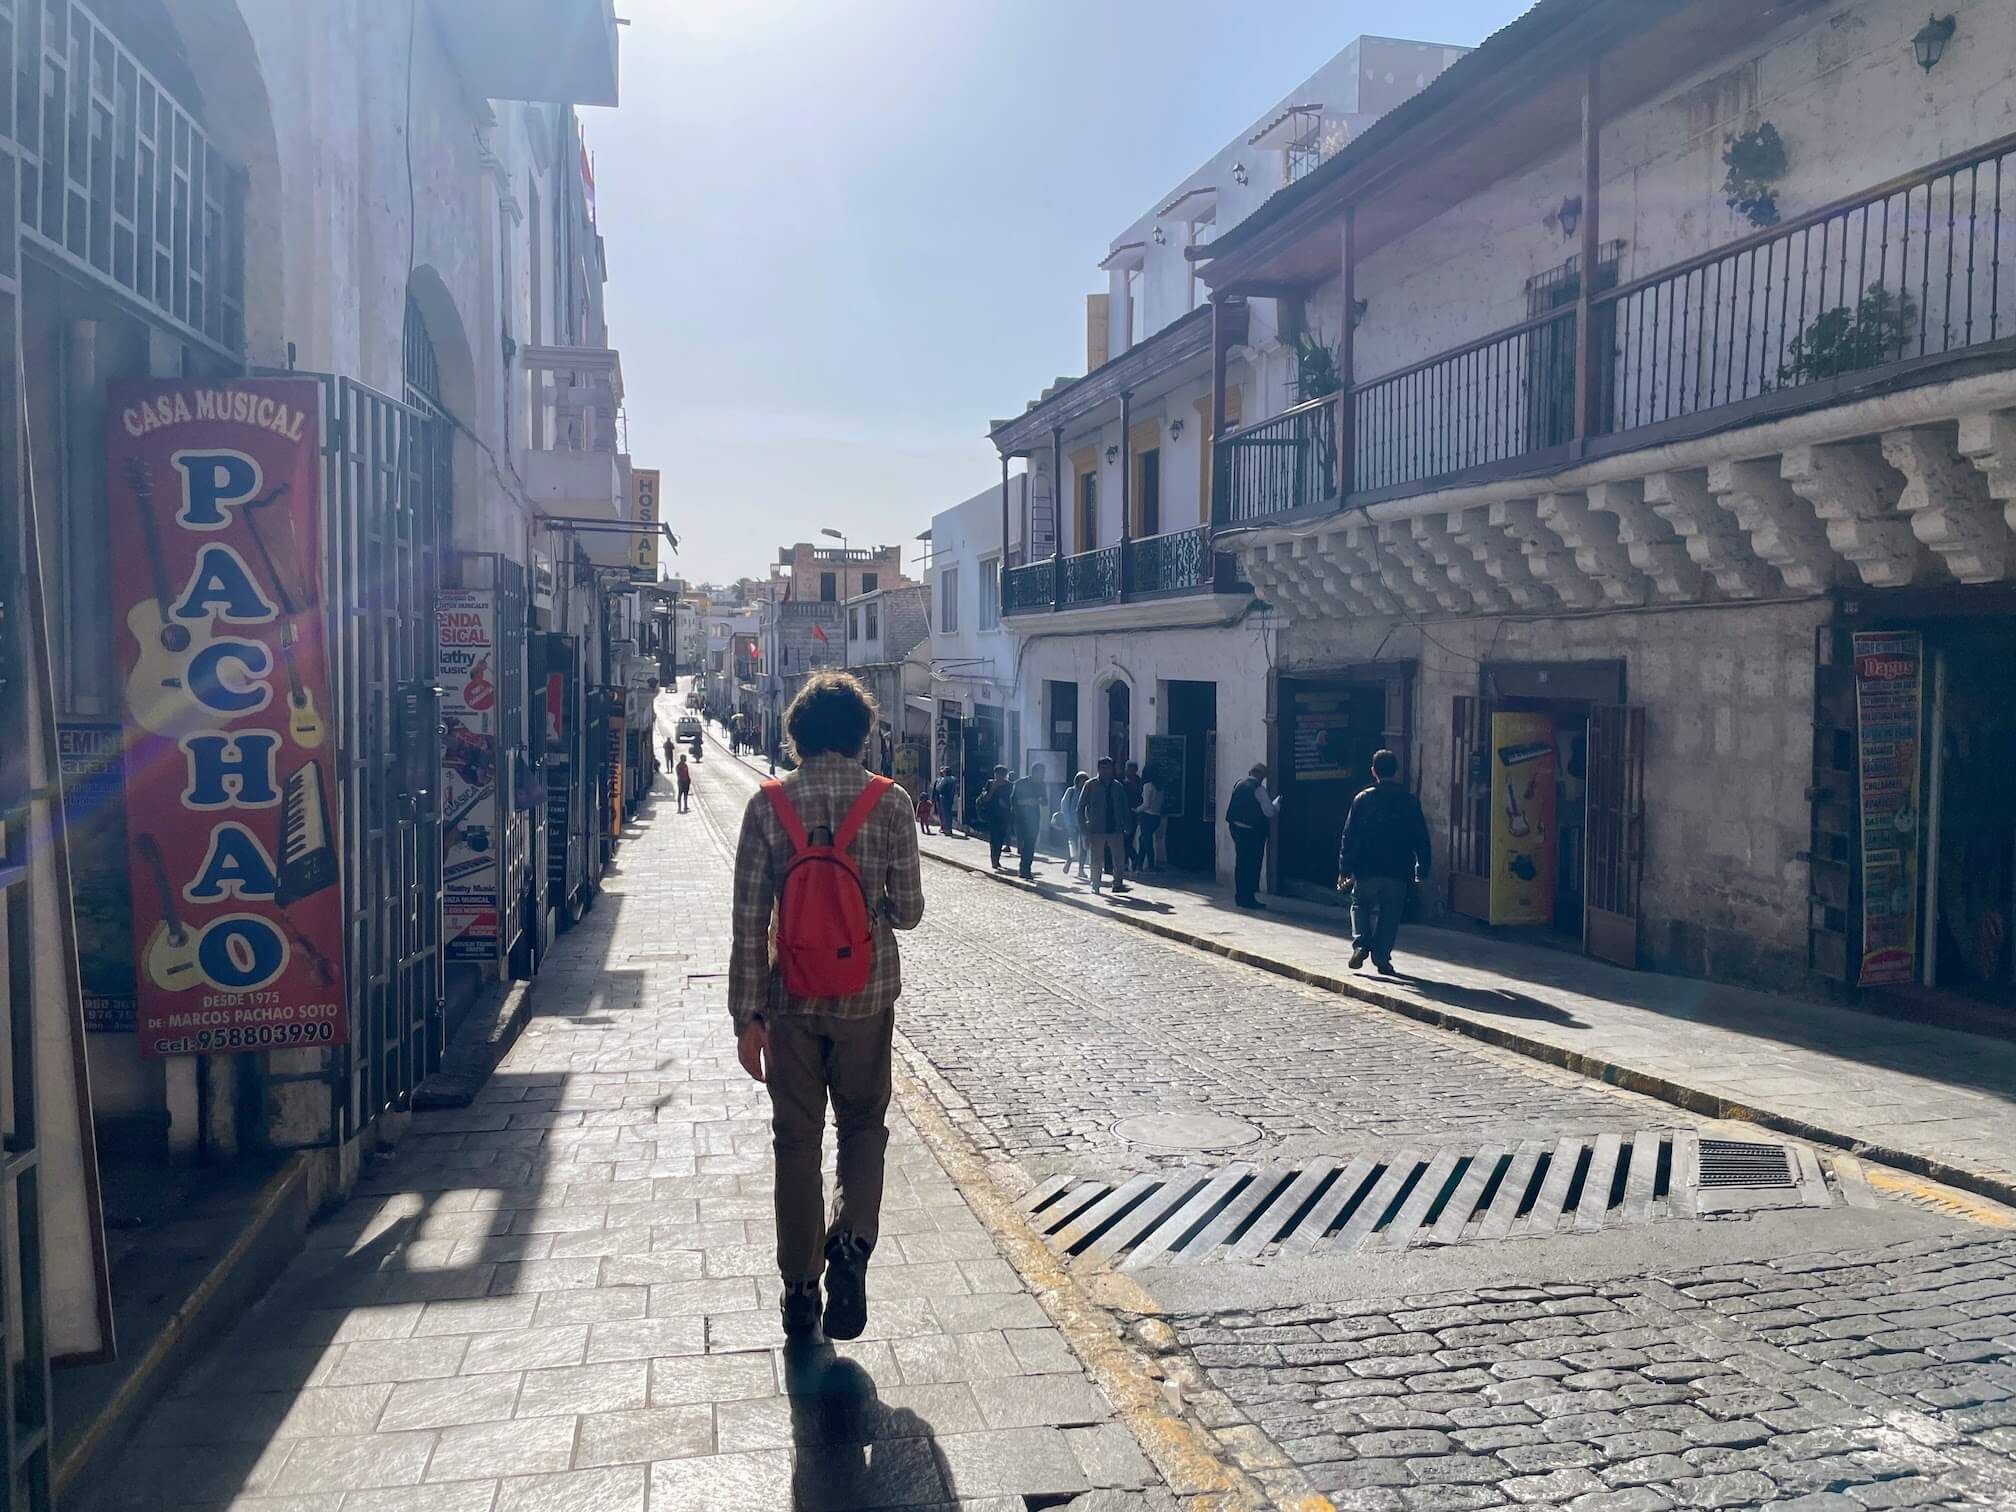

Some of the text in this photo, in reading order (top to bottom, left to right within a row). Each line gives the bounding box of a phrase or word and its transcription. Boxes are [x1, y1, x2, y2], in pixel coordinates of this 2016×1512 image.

[123, 390, 304, 441] CASA MUSICAL
[168, 448, 291, 992] PACHAO
[168, 1011, 230, 1027] MARCOS
[235, 1006, 294, 1022] PACHAO
[299, 1004, 338, 1018] SOTO
[204, 992, 280, 1008] DESDE 1975
